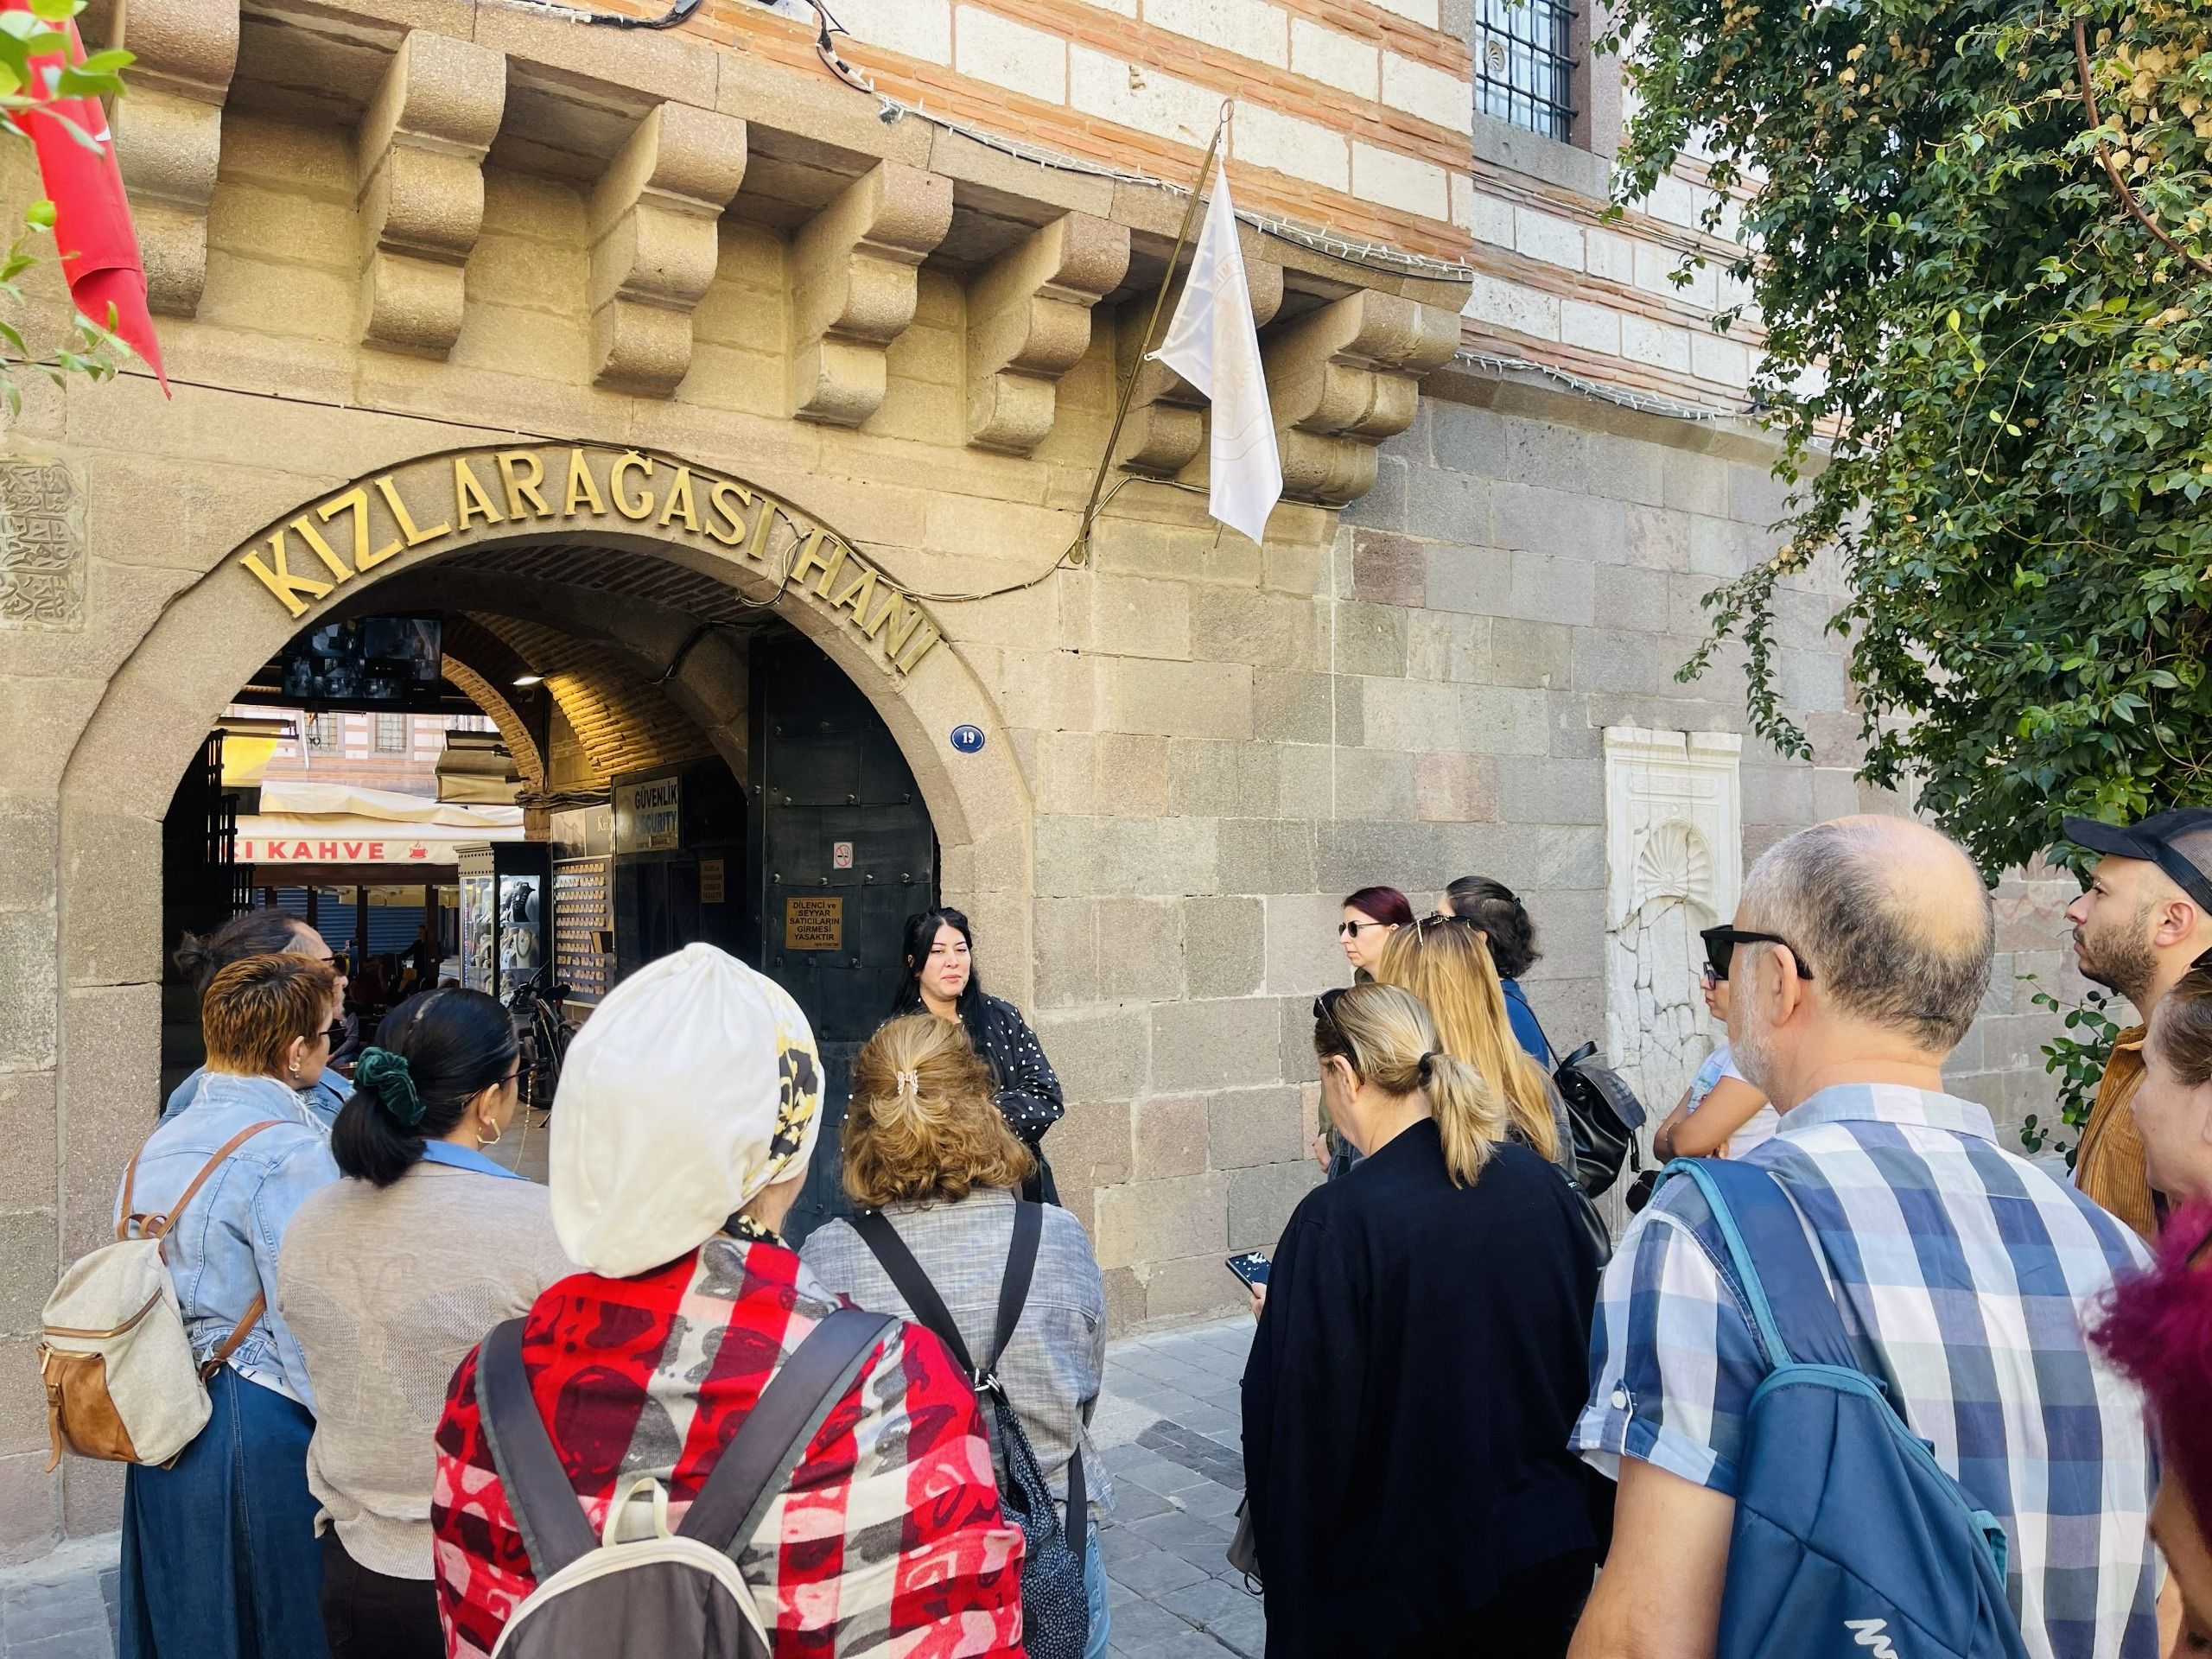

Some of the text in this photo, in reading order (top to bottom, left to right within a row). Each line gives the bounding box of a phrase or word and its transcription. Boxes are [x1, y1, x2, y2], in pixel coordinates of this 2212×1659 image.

[238, 448, 941, 677] KIZLARAĞASI HANI
[963, 731, 975, 744] 19
[635, 780, 677, 810] GÜVENLİK
[636, 810, 677, 834] ECURITY
[268, 842, 385, 859] KAHVE
[793, 900, 825, 909] DİLENCİ
